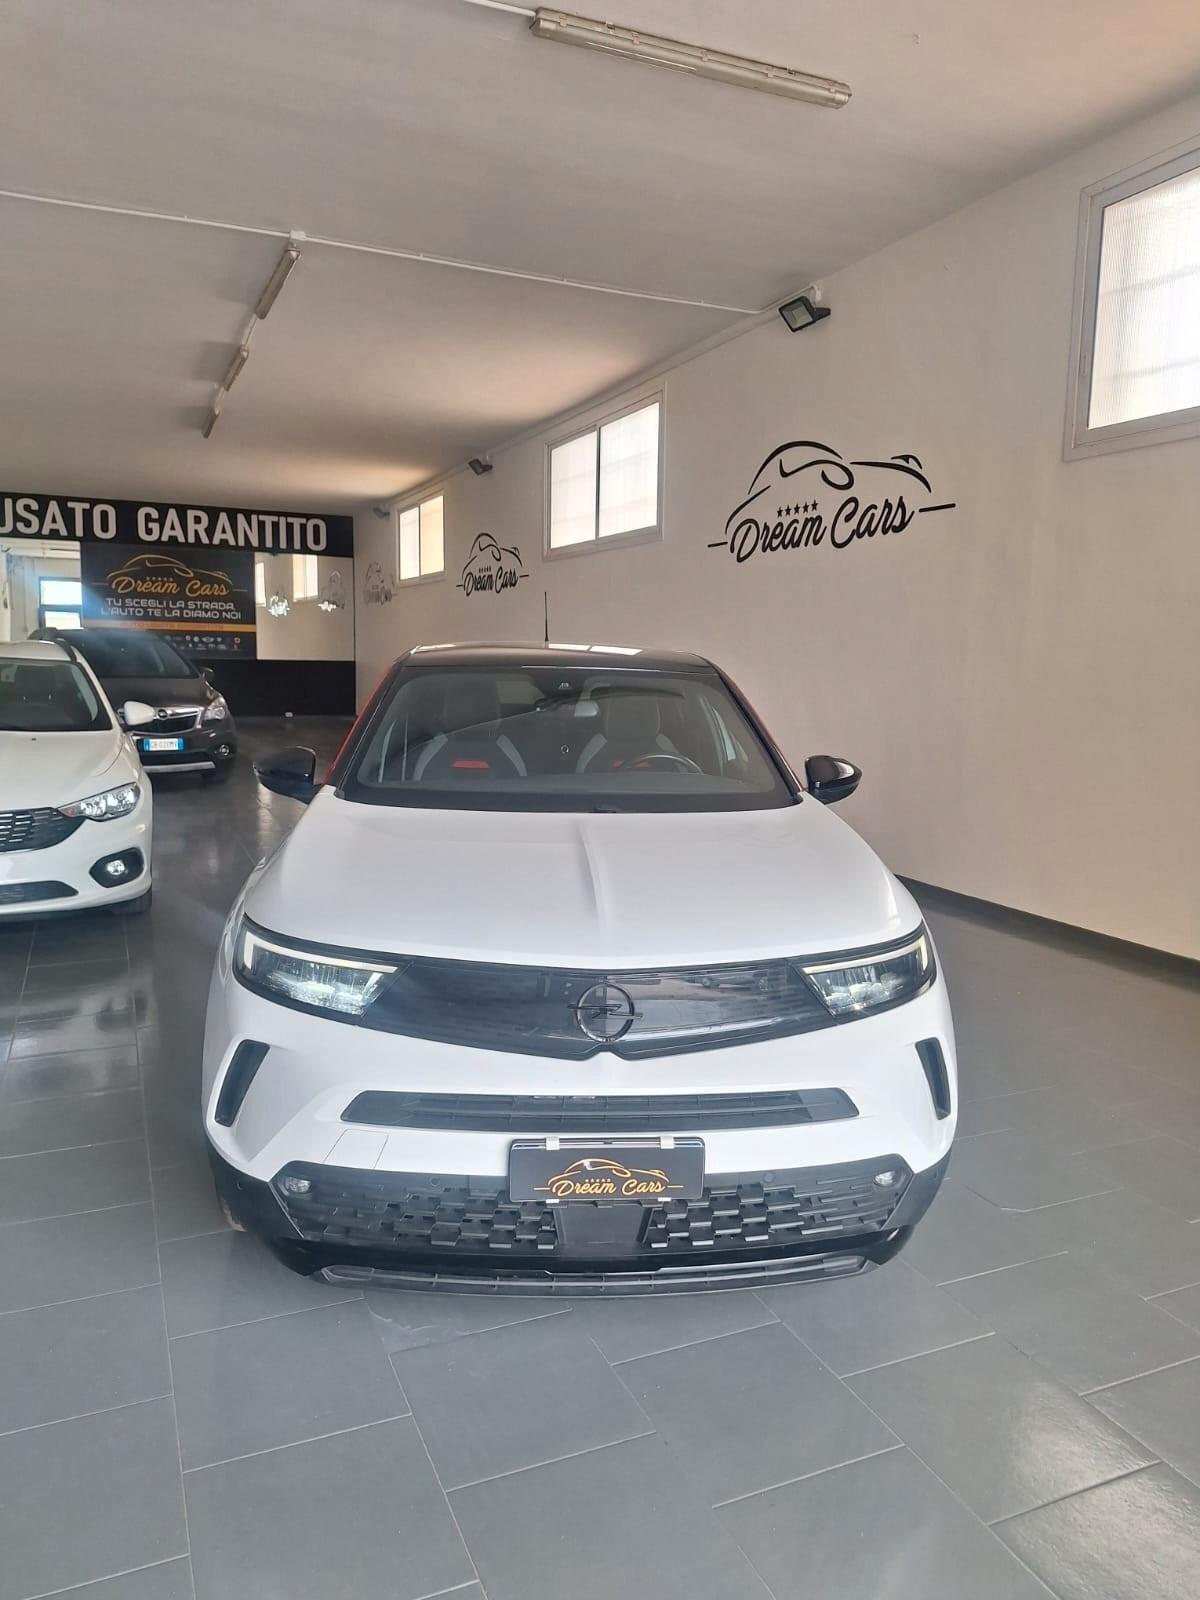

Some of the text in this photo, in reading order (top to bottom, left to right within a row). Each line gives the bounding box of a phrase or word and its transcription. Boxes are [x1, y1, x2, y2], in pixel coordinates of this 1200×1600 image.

[136, 506, 328, 551] GARANTITO
[729, 496, 915, 563] Dream Cars
[111, 576, 229, 597] Dream Cars
[463, 566, 519, 597] Dream Cars
[101, 607, 241, 620] L'AUTO TE LA DIAMO NOI
[106, 598, 122, 607] TU
[125, 599, 167, 608] SCEGLI
[169, 601, 185, 609] LA
[551, 1179, 667, 1197] Dream Cars
